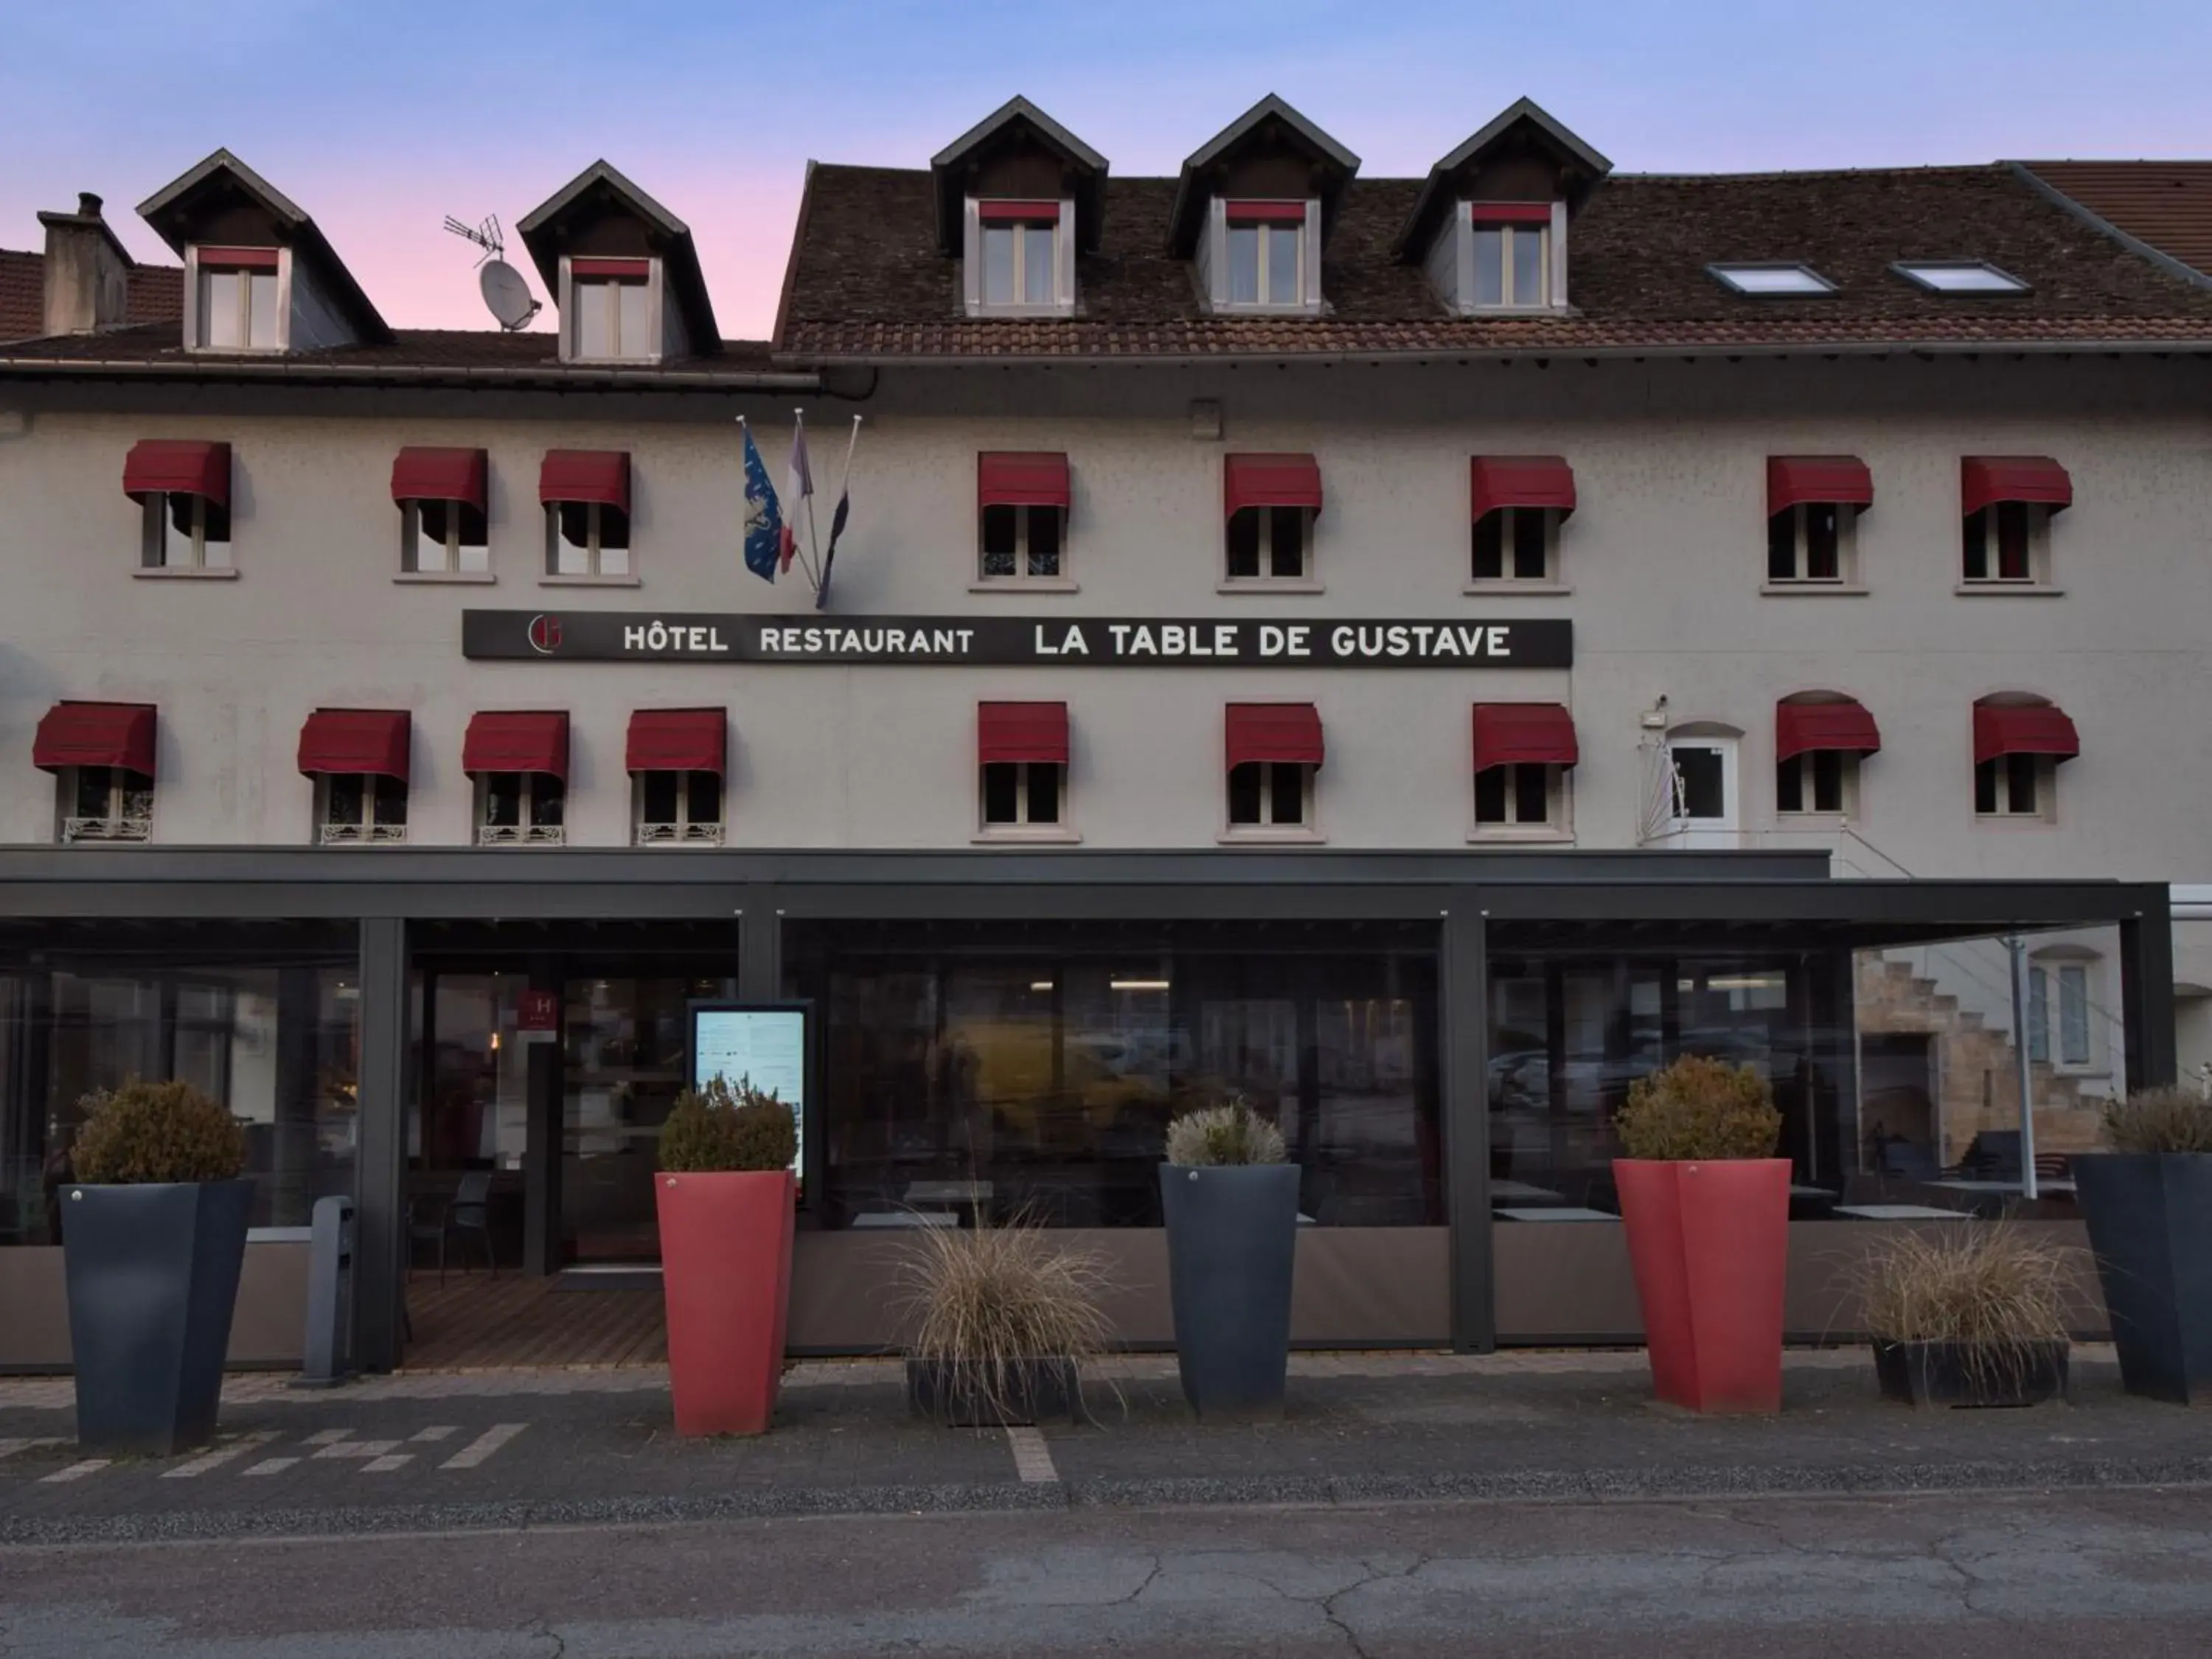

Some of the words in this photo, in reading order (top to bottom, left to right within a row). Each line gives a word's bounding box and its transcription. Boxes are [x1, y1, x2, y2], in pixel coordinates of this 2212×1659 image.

[625, 620, 728, 651] HÔTEL
[760, 627, 974, 653] RESTAURANT
[1035, 625, 1089, 654] LA
[1108, 625, 1239, 655] TABLE
[1259, 625, 1311, 655] DE
[1332, 625, 1511, 656] GUSTAVE
[537, 998, 551, 1013] H
